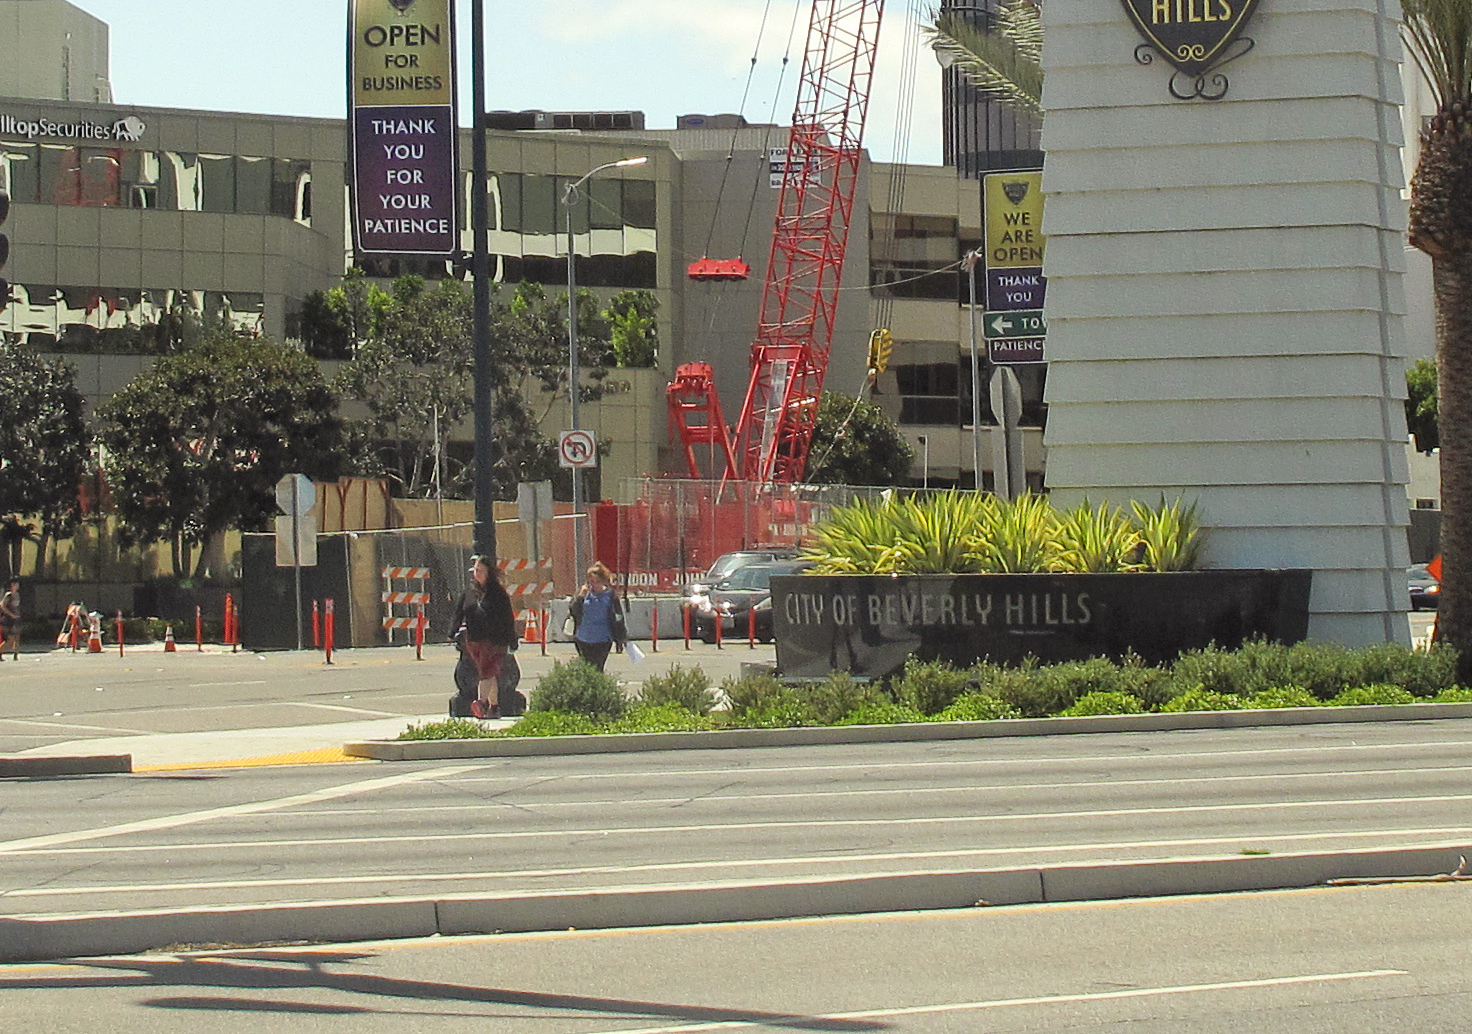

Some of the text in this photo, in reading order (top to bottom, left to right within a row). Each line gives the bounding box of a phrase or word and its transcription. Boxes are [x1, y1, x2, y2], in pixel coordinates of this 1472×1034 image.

[363, 23, 441, 47] OPEN
[384, 53, 420, 69] FOR
[362, 75, 443, 92] BUSINESS
[371, 118, 437, 135] THANK
[383, 144, 425, 160] YOU
[387, 169, 424, 185] FOR
[379, 193, 433, 209] YOUR
[364, 218, 449, 235] PATIENCE
[1003, 211, 1031, 227] WE
[1001, 229, 1035, 244] ARE
[993, 246, 1043, 262] OPEN
[998, 275, 1040, 287] THANK
[1005, 291, 1033, 303] YOU
[993, 339, 1045, 351] PATIENC
[784, 592, 1092, 626] CITY OF BEVERLY HILLS
